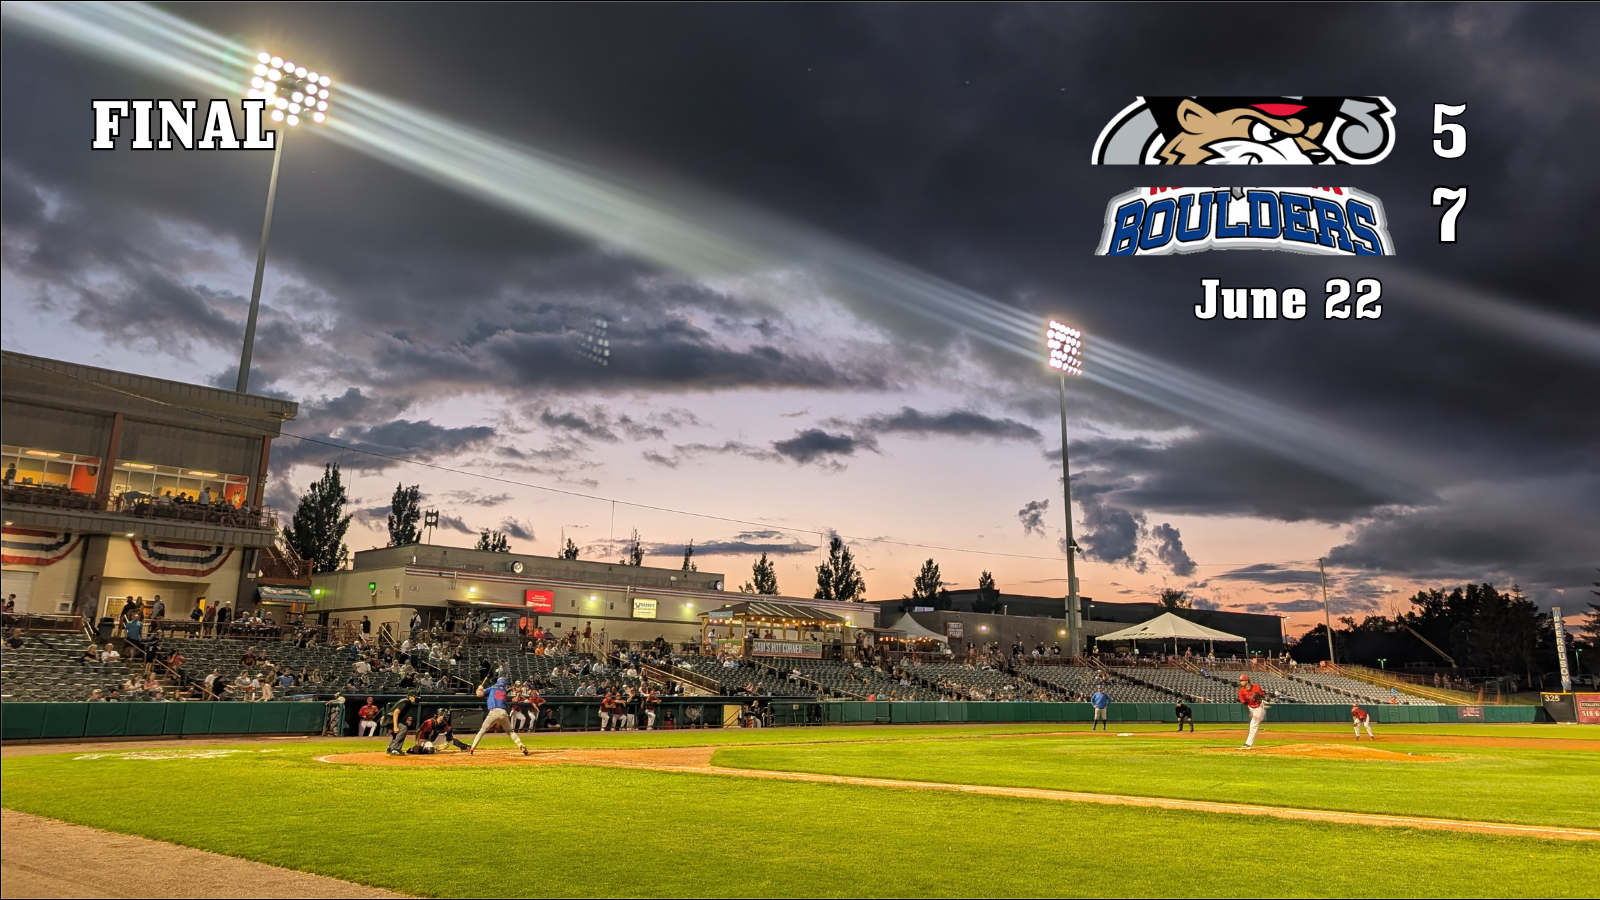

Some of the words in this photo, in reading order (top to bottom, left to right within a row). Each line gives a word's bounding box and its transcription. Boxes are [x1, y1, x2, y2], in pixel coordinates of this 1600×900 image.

[782, 643, 803, 654] CORNER
[1554, 622, 1571, 683] FERGUSON
[1544, 694, 1560, 702] 325
